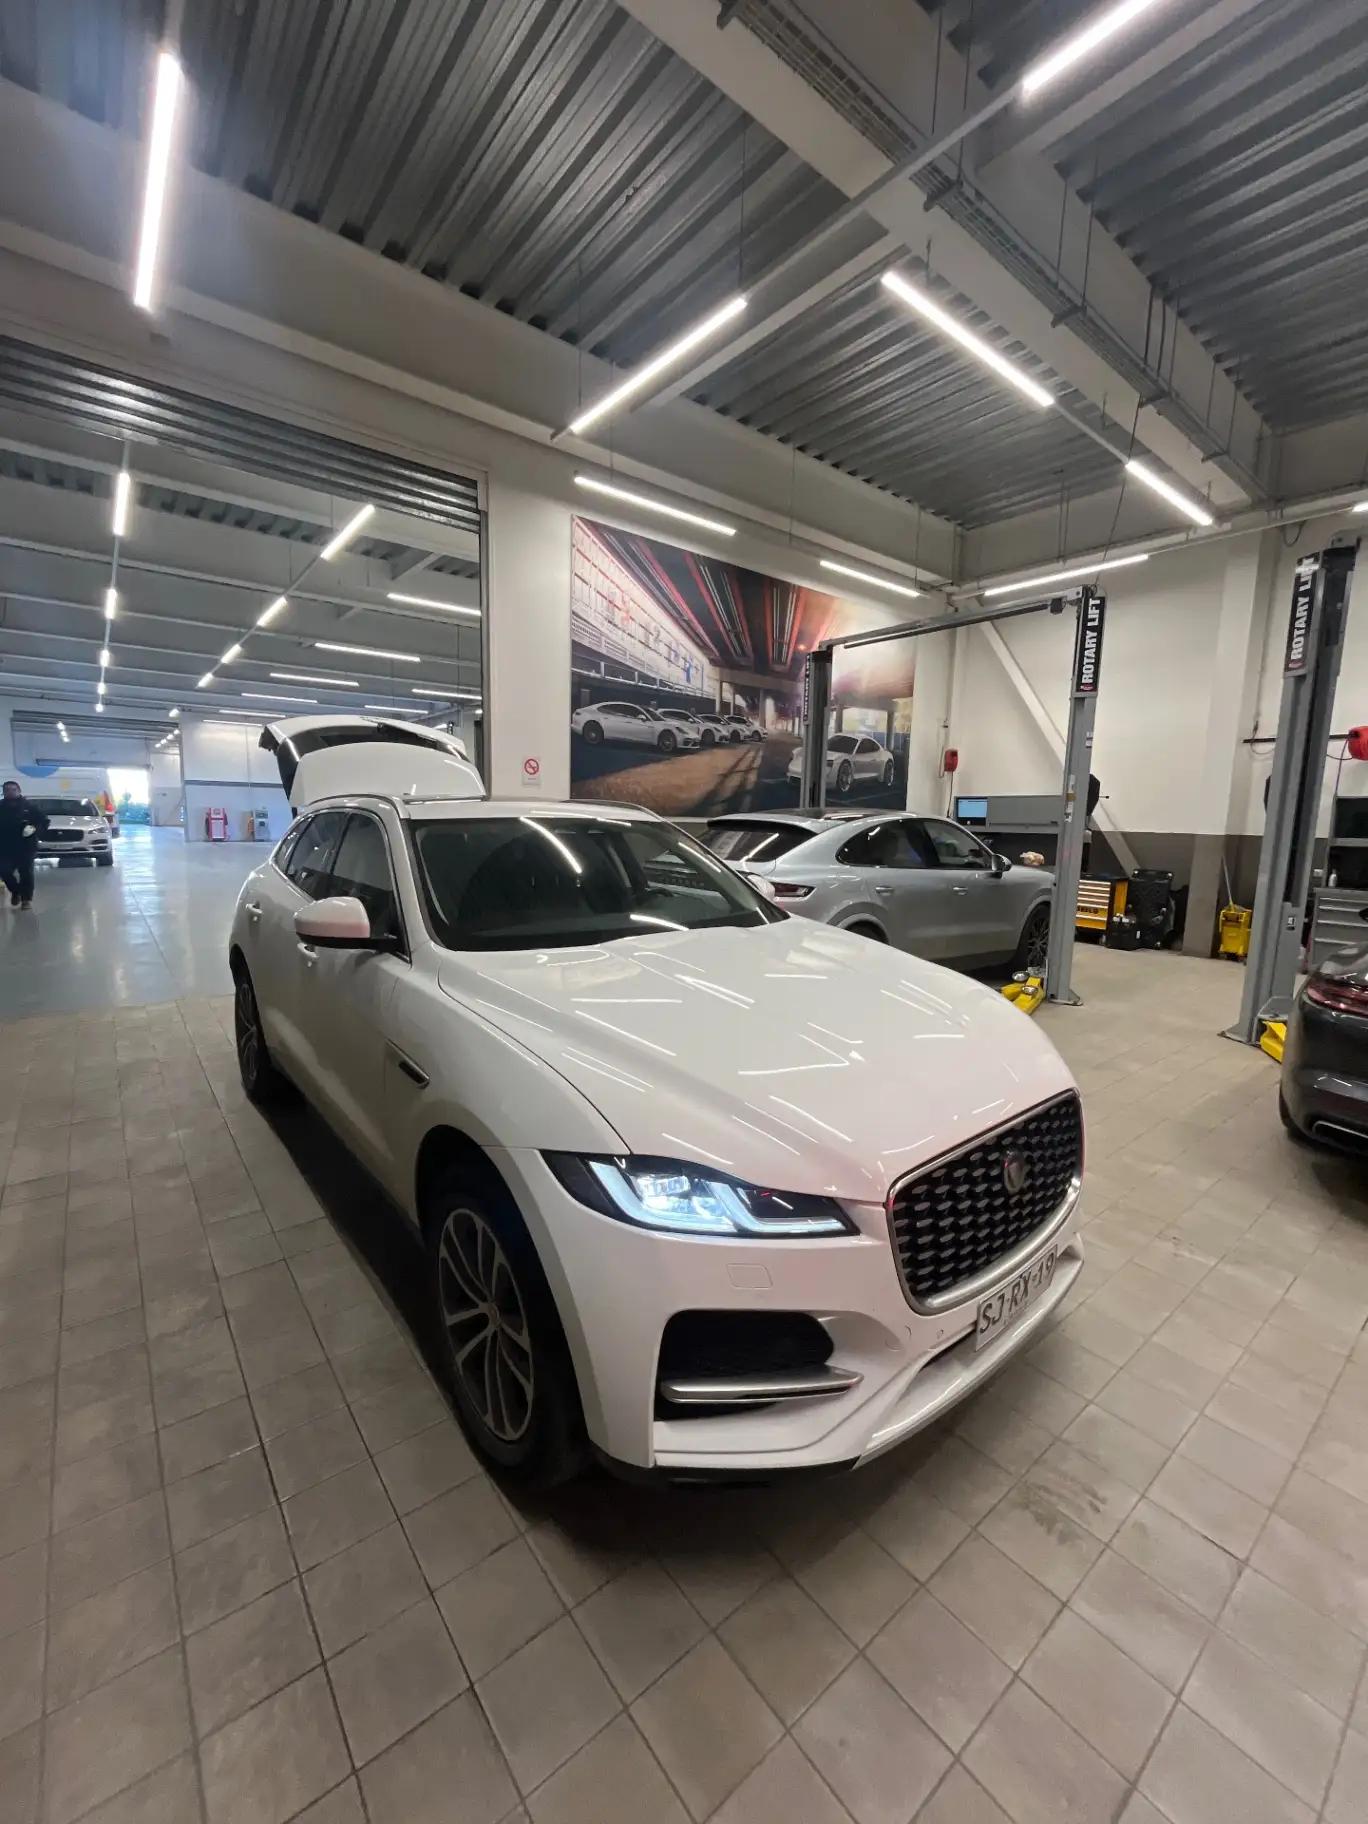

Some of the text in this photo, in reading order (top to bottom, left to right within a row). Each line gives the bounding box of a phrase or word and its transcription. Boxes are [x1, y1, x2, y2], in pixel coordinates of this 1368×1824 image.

[1087, 598, 1102, 627] LIFT
[1290, 597, 1310, 660] ROTARY
[1081, 630, 1098, 684] ROTARY
